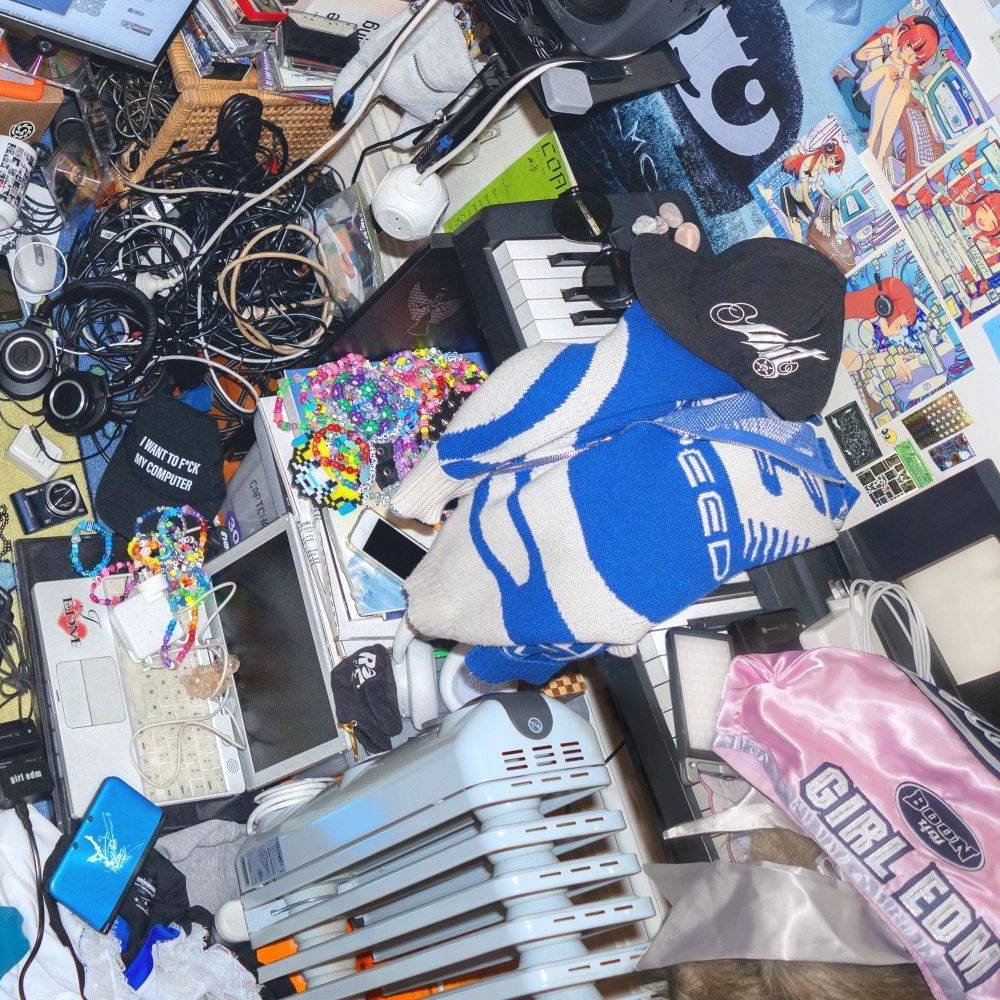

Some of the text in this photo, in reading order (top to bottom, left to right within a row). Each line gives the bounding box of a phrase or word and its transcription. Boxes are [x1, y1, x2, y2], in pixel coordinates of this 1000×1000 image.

[133, 453, 193, 492] MY COMPUTER
[139, 435, 148, 447] I
[145, 438, 167, 461] WANT
[167, 451, 181, 468] TO
[227, 520, 240, 545] 30
[62, 595, 82, 648] EDM
[9, 770, 43, 785] girl edm
[802, 763, 911, 883] GIRL
[902, 787, 981, 864] BOON
[897, 868, 1000, 988] EDM
